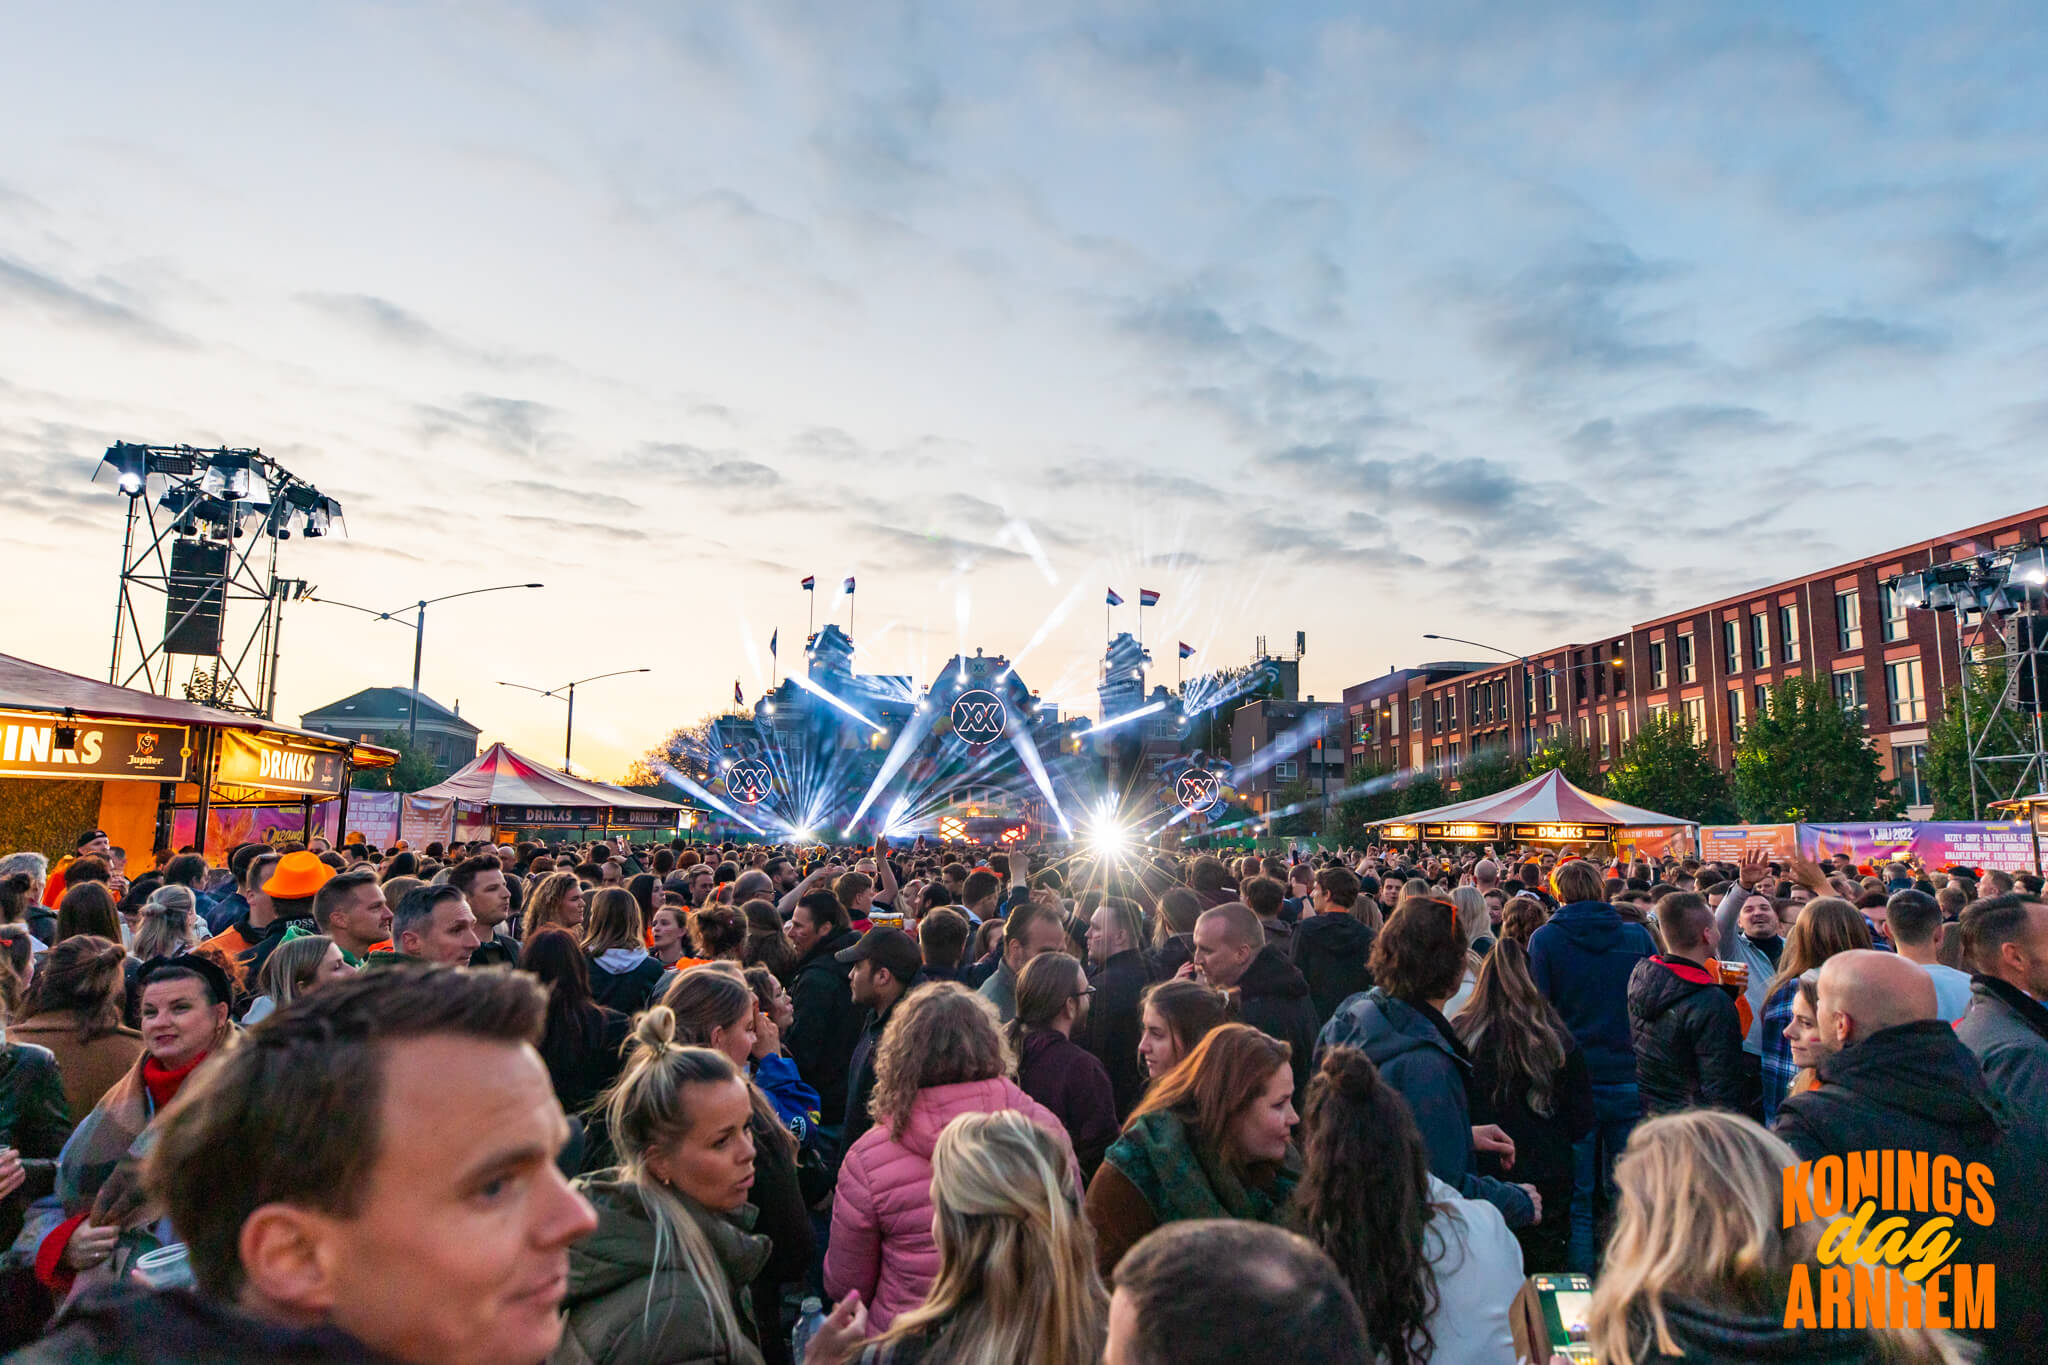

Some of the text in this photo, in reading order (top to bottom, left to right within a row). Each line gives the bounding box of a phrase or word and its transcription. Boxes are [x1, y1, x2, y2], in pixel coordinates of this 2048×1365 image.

[0, 725, 104, 765] INS
[127, 755, 164, 768] Jupiler
[259, 748, 316, 782] DRINKS
[1876, 828, 1892, 840] JULI
[1893, 828, 1914, 840] 2022
[286, 919, 315, 929] BOSS
